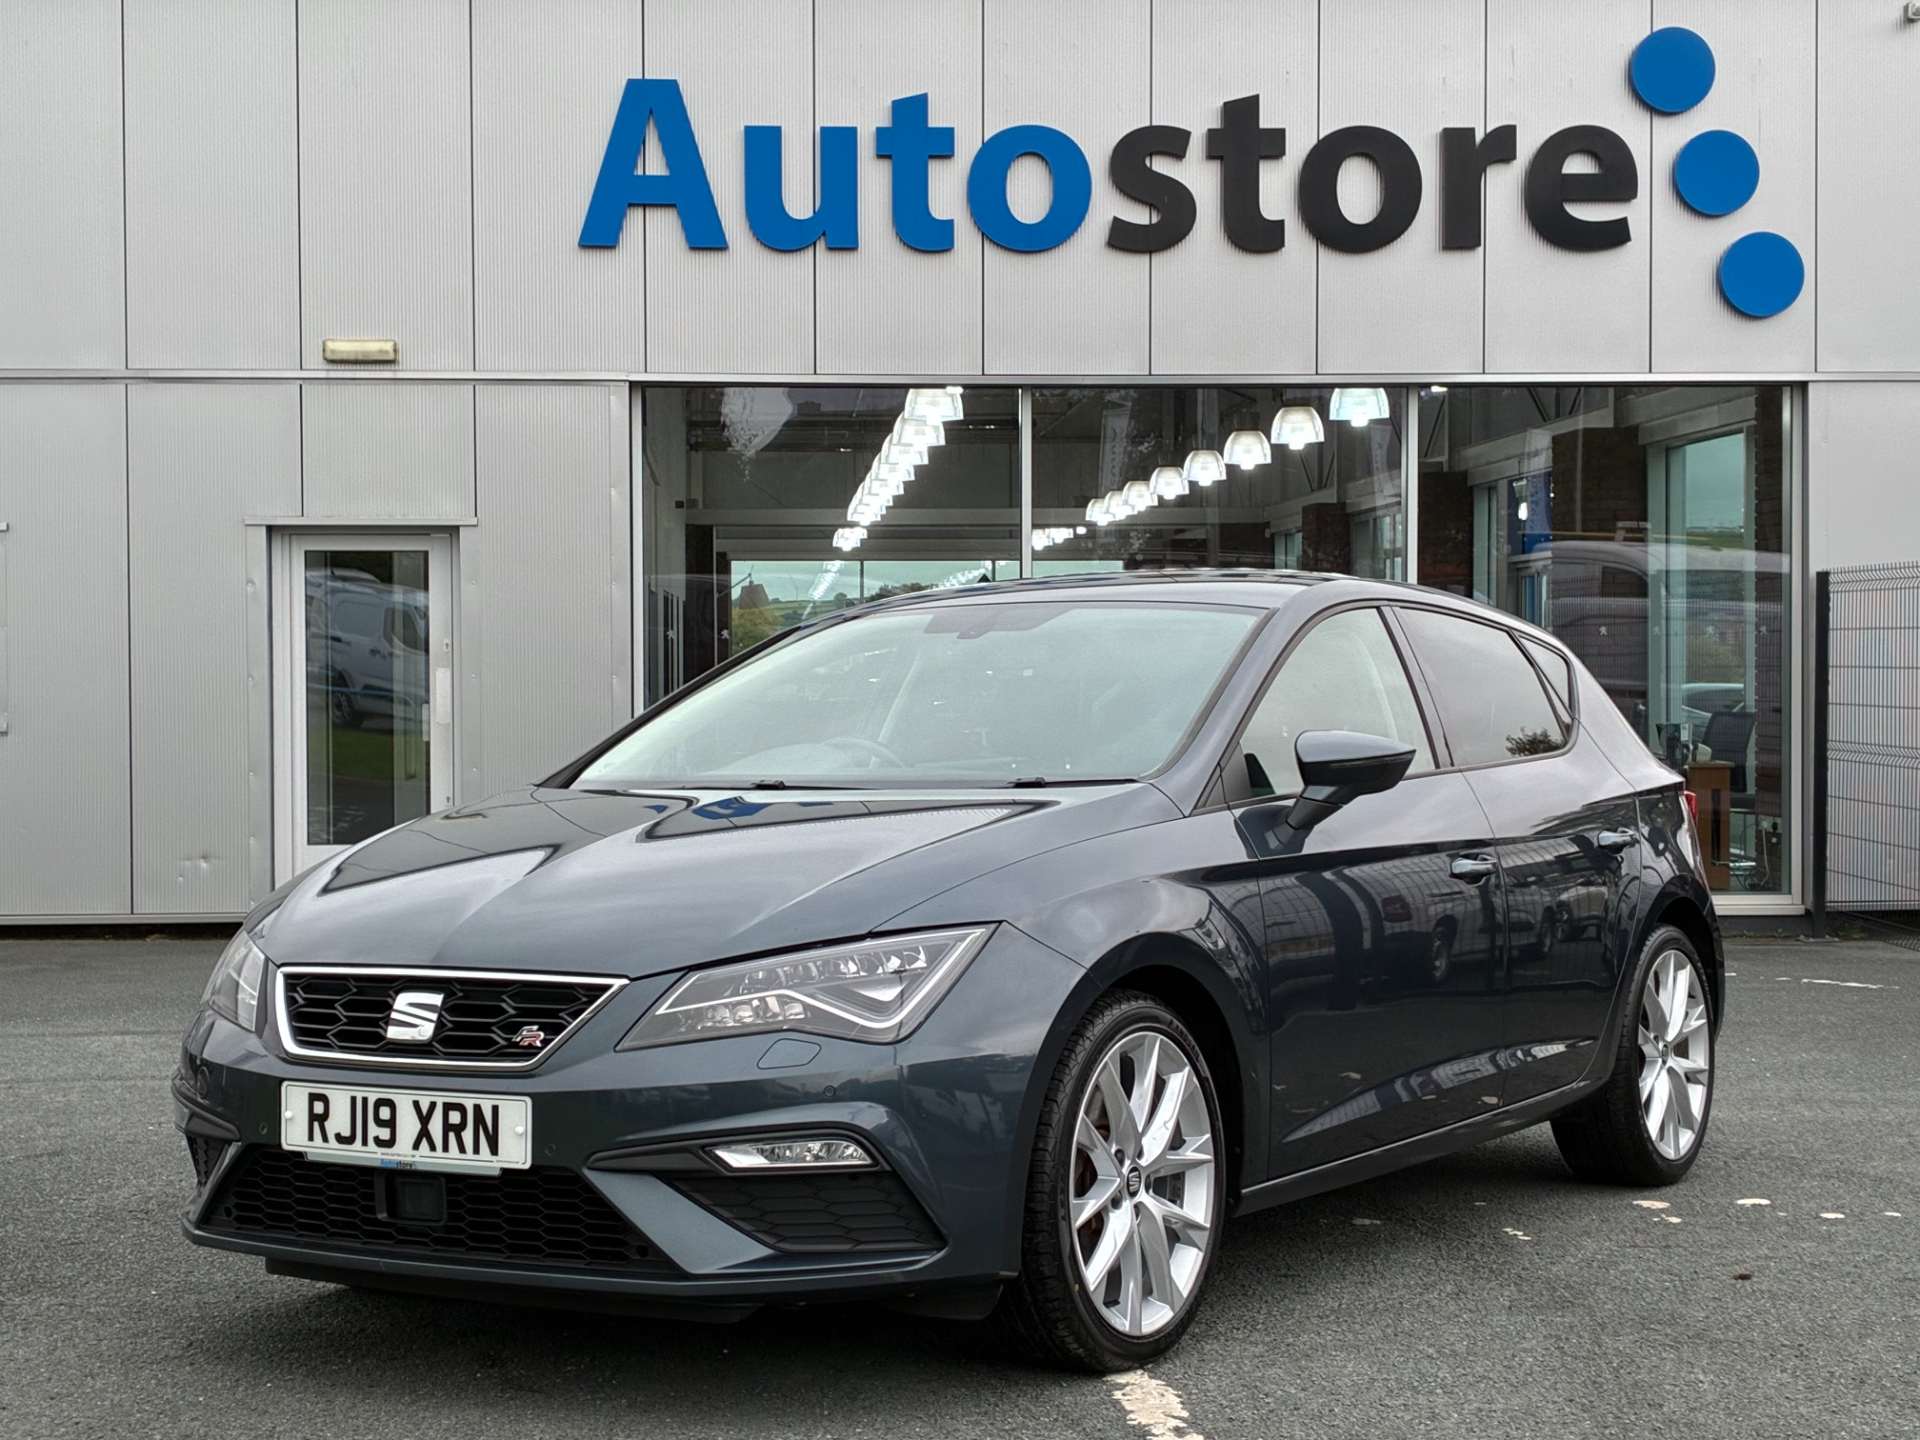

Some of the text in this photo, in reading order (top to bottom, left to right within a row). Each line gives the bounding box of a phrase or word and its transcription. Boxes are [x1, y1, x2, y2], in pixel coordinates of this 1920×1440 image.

[578, 79, 1638, 254] Autostore
[307, 1092, 500, 1156] RJ19 XRN
